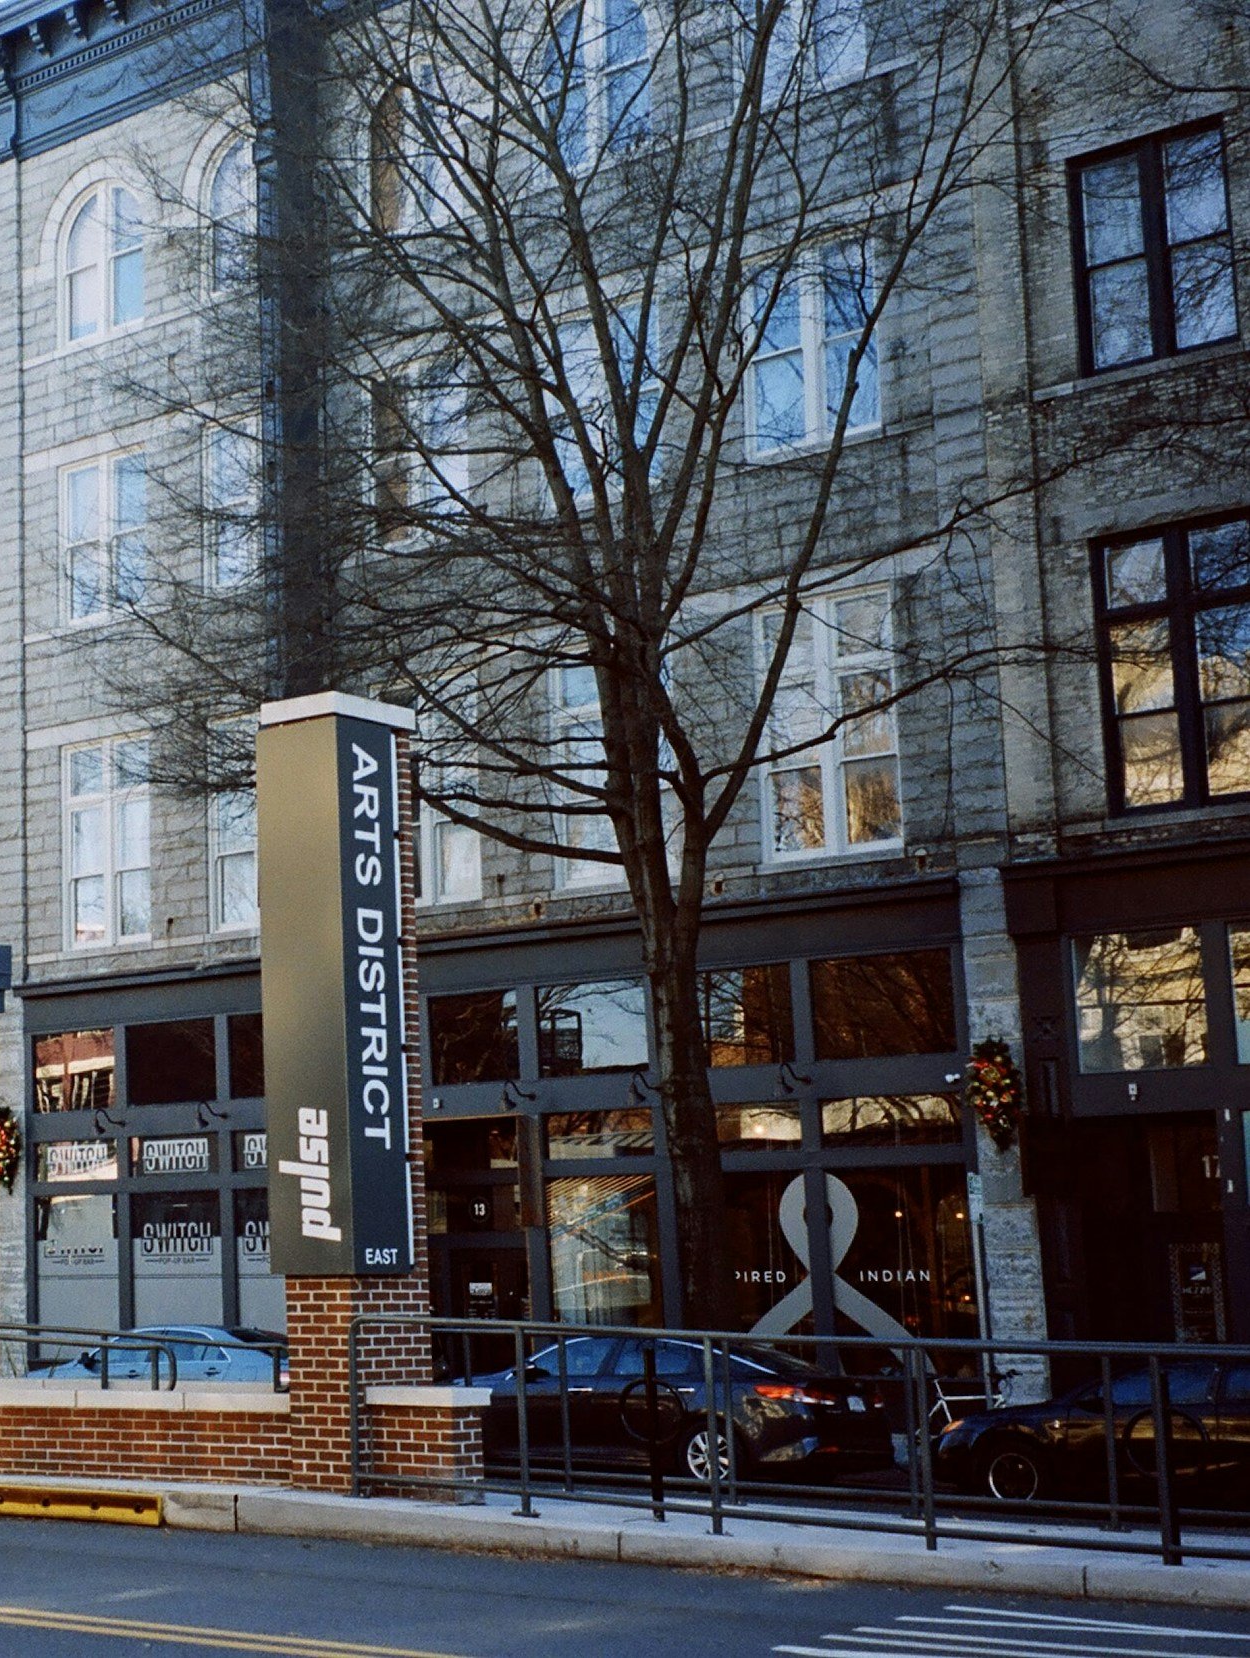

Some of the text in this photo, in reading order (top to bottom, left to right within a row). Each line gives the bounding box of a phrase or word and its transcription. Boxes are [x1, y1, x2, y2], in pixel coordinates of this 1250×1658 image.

[352, 742, 392, 1150] ARTS DISTRICT
[146, 1141, 207, 1171] SWITCH
[278, 1107, 342, 1242] pulse
[474, 1203, 486, 1216] 13
[143, 1221, 212, 1253] SWITCH
[365, 1247, 398, 1265] EAST
[859, 1269, 931, 1283] INDIAN
